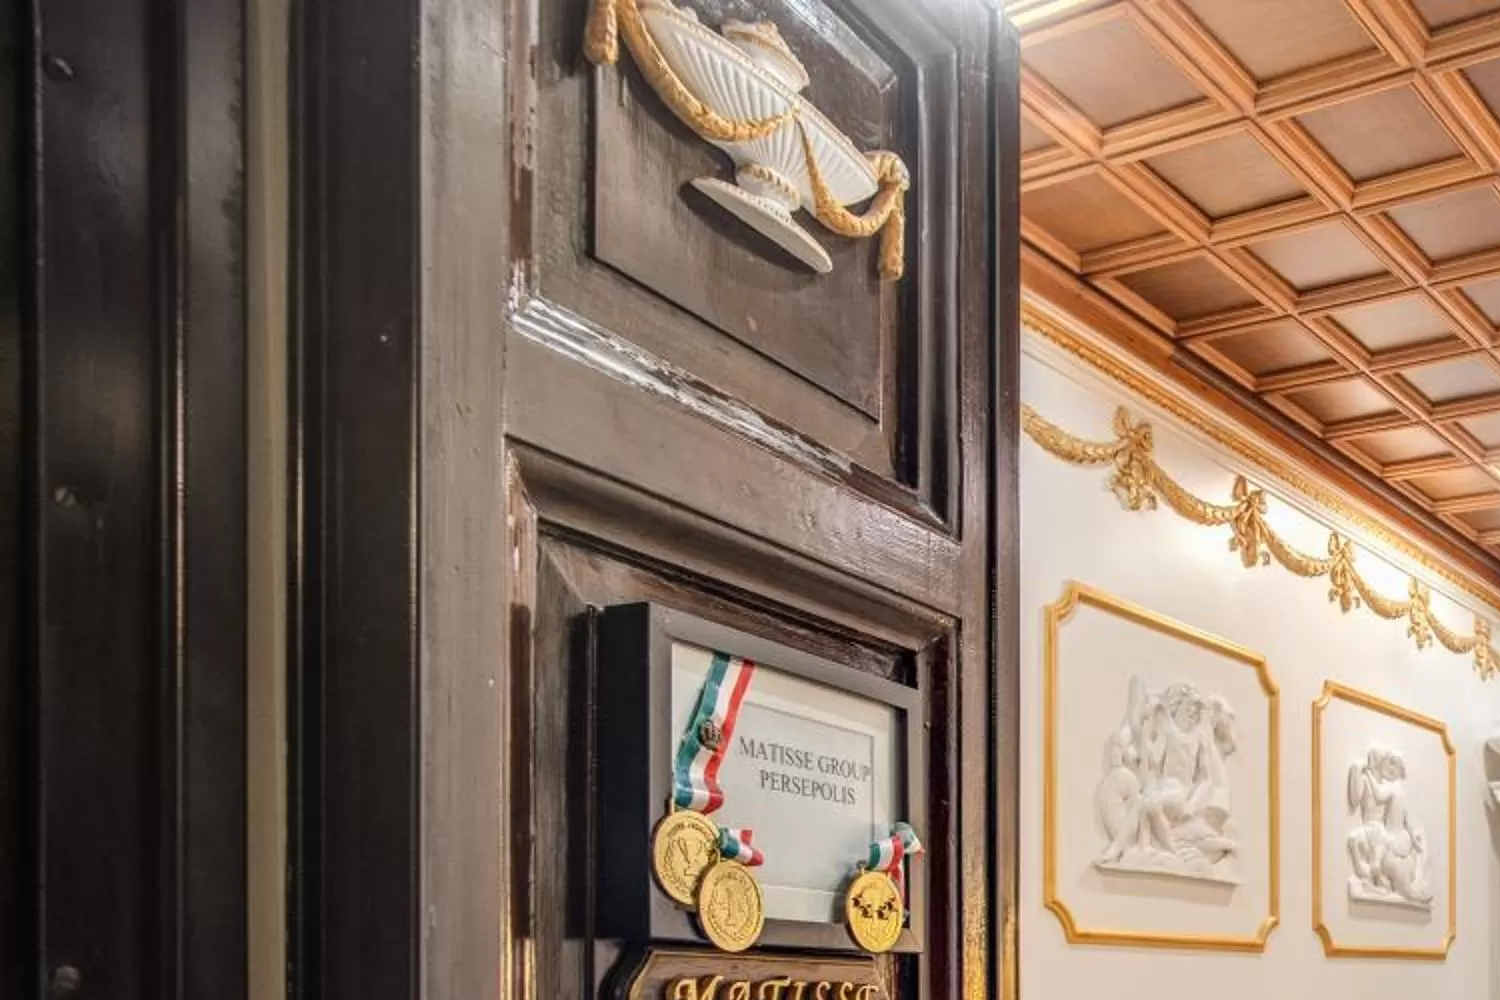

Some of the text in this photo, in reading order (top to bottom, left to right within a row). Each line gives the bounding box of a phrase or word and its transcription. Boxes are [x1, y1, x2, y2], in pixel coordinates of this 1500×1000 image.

[739, 735, 873, 782] MATISSE GROUP
[759, 769, 856, 805] PERSEPOLIS
